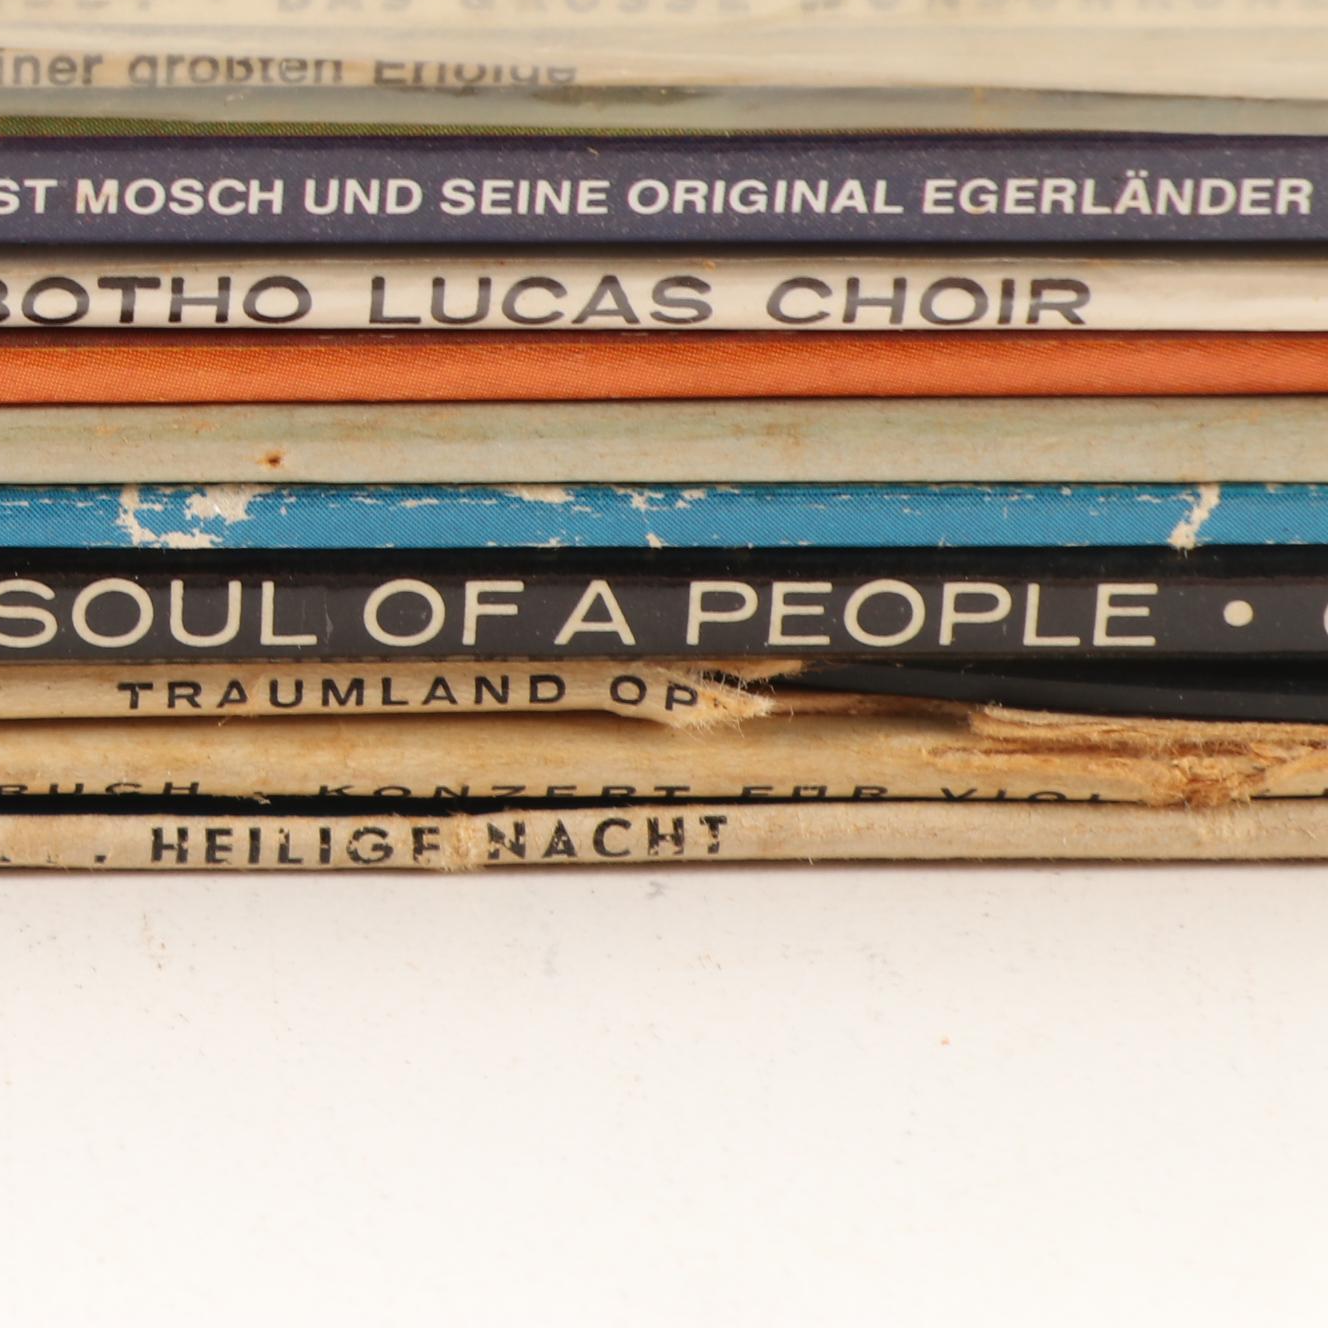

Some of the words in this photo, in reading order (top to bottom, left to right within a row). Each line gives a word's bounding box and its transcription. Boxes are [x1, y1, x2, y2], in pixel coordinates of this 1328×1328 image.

[75, 177, 284, 216] MOSCH
[303, 177, 424, 216] UND
[439, 177, 611, 216] SEINE
[627, 177, 905, 216] ORIGINAL
[921, 168, 1314, 216] EGERLÄNDER
[368, 274, 714, 326] LUCAS
[765, 274, 1094, 326] CHOIR
[362, 578, 526, 649] OF
[553, 578, 638, 647] A
[685, 577, 1160, 649] PEOPLE
[116, 674, 567, 711] TRAUMLAND
[150, 824, 442, 865] HEILIGE
[486, 815, 730, 860] NACHT
